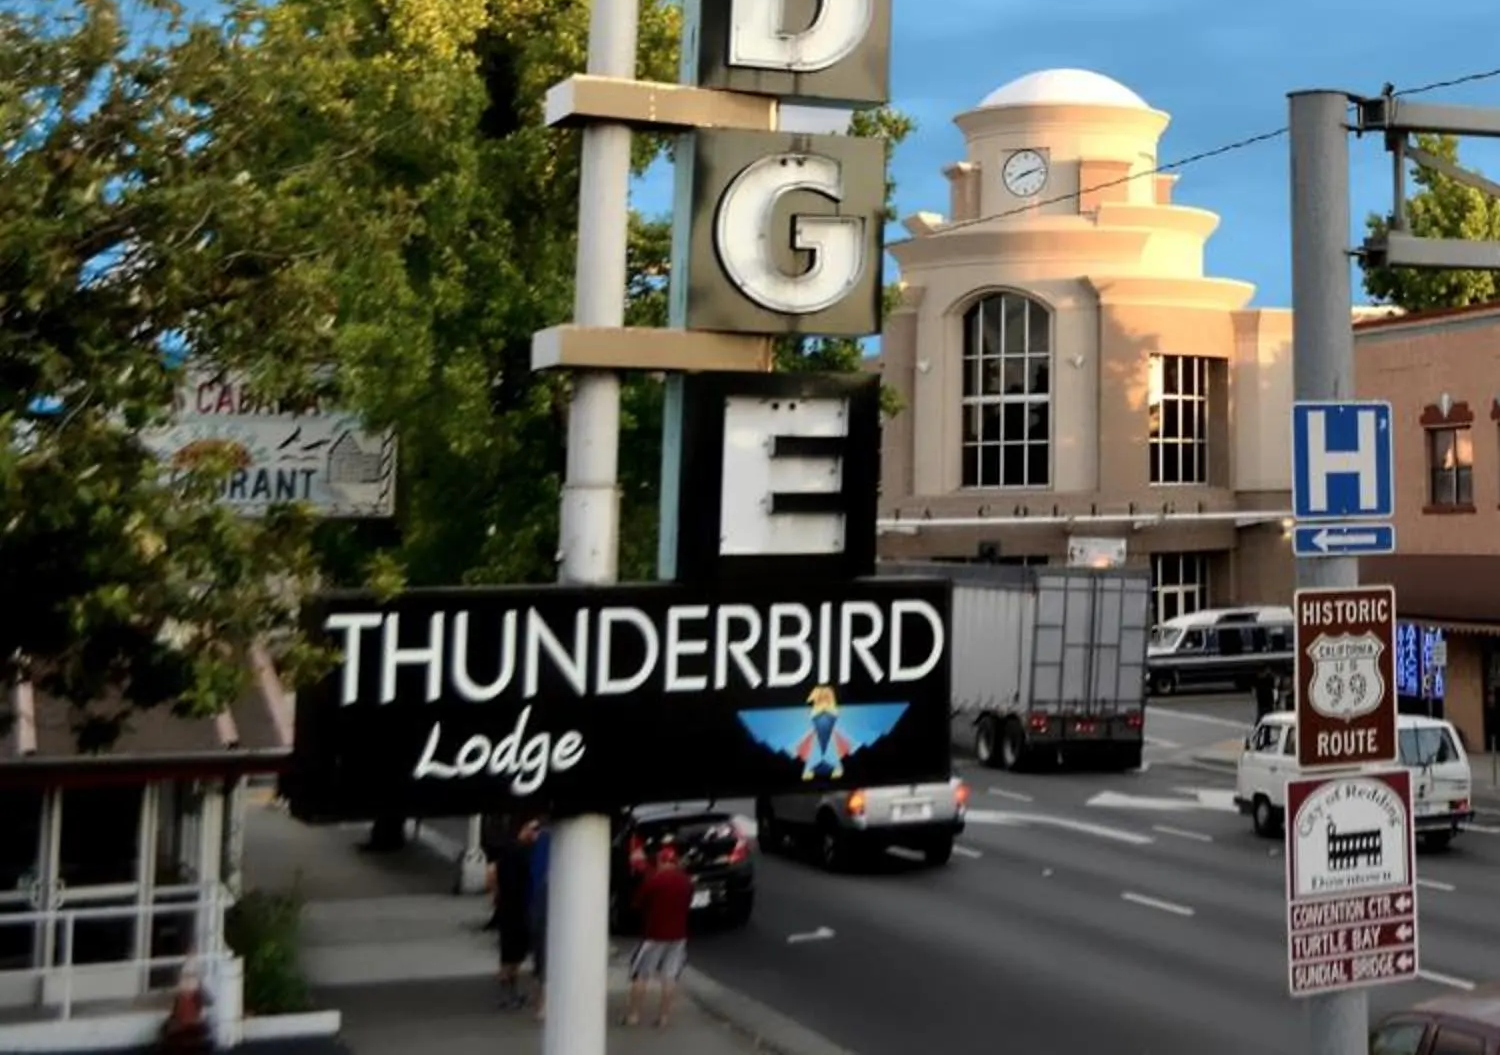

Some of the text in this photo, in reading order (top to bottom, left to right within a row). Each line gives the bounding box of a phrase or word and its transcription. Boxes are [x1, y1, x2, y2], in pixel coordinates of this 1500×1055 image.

[1306, 409, 1379, 512] H
[1302, 598, 1389, 626] HISTORIC
[325, 599, 945, 707] THUNDERBIRD
[1325, 673, 1368, 708] 99
[412, 704, 586, 796] Lodge
[1317, 728, 1379, 757] ROUTE
[1345, 783, 1401, 829] Redding
[1293, 898, 1366, 929] CONVENTION
[1294, 925, 1381, 958] TURTLE BAY
[1294, 959, 1348, 989] SUNDIAL
